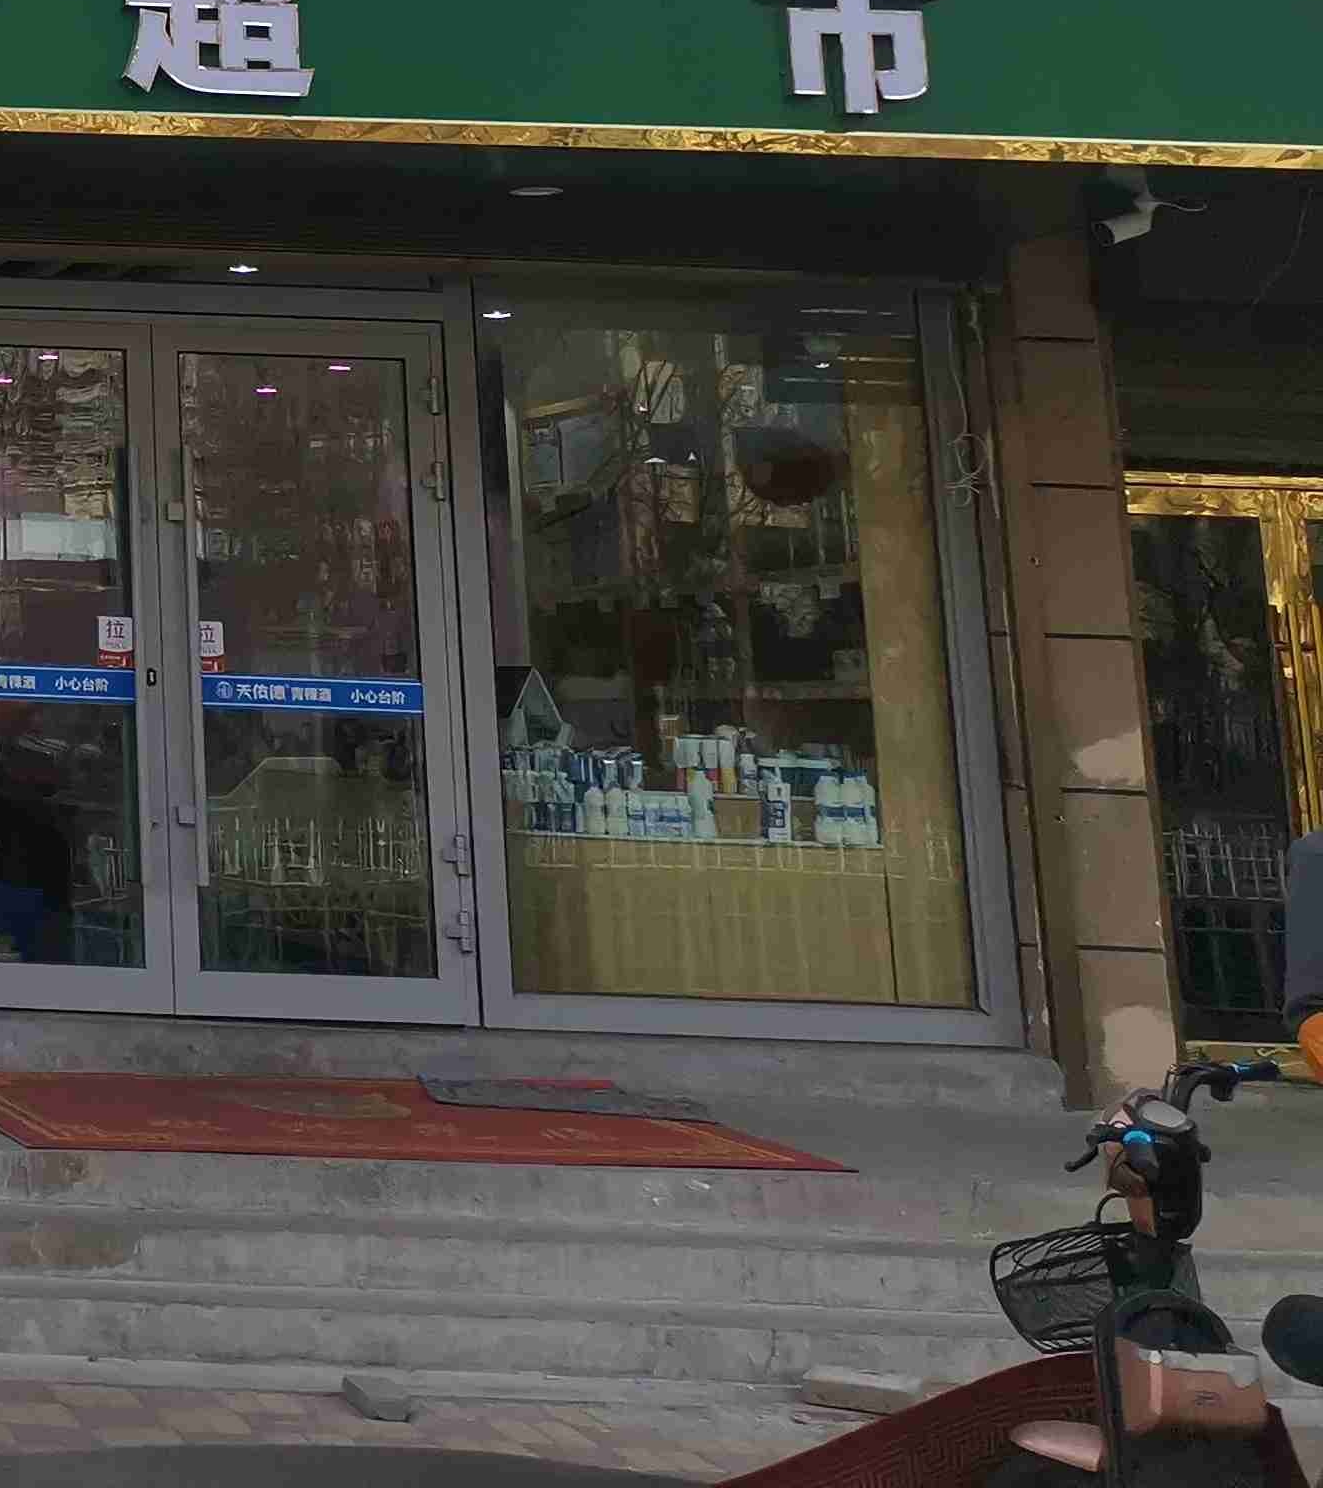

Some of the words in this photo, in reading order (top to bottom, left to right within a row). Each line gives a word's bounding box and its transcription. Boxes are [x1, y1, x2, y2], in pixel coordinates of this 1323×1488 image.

[106, 620, 125, 639] 拉
[54, 676, 110, 693] 小心台阶
[350, 689, 406, 705] 小心台阶
